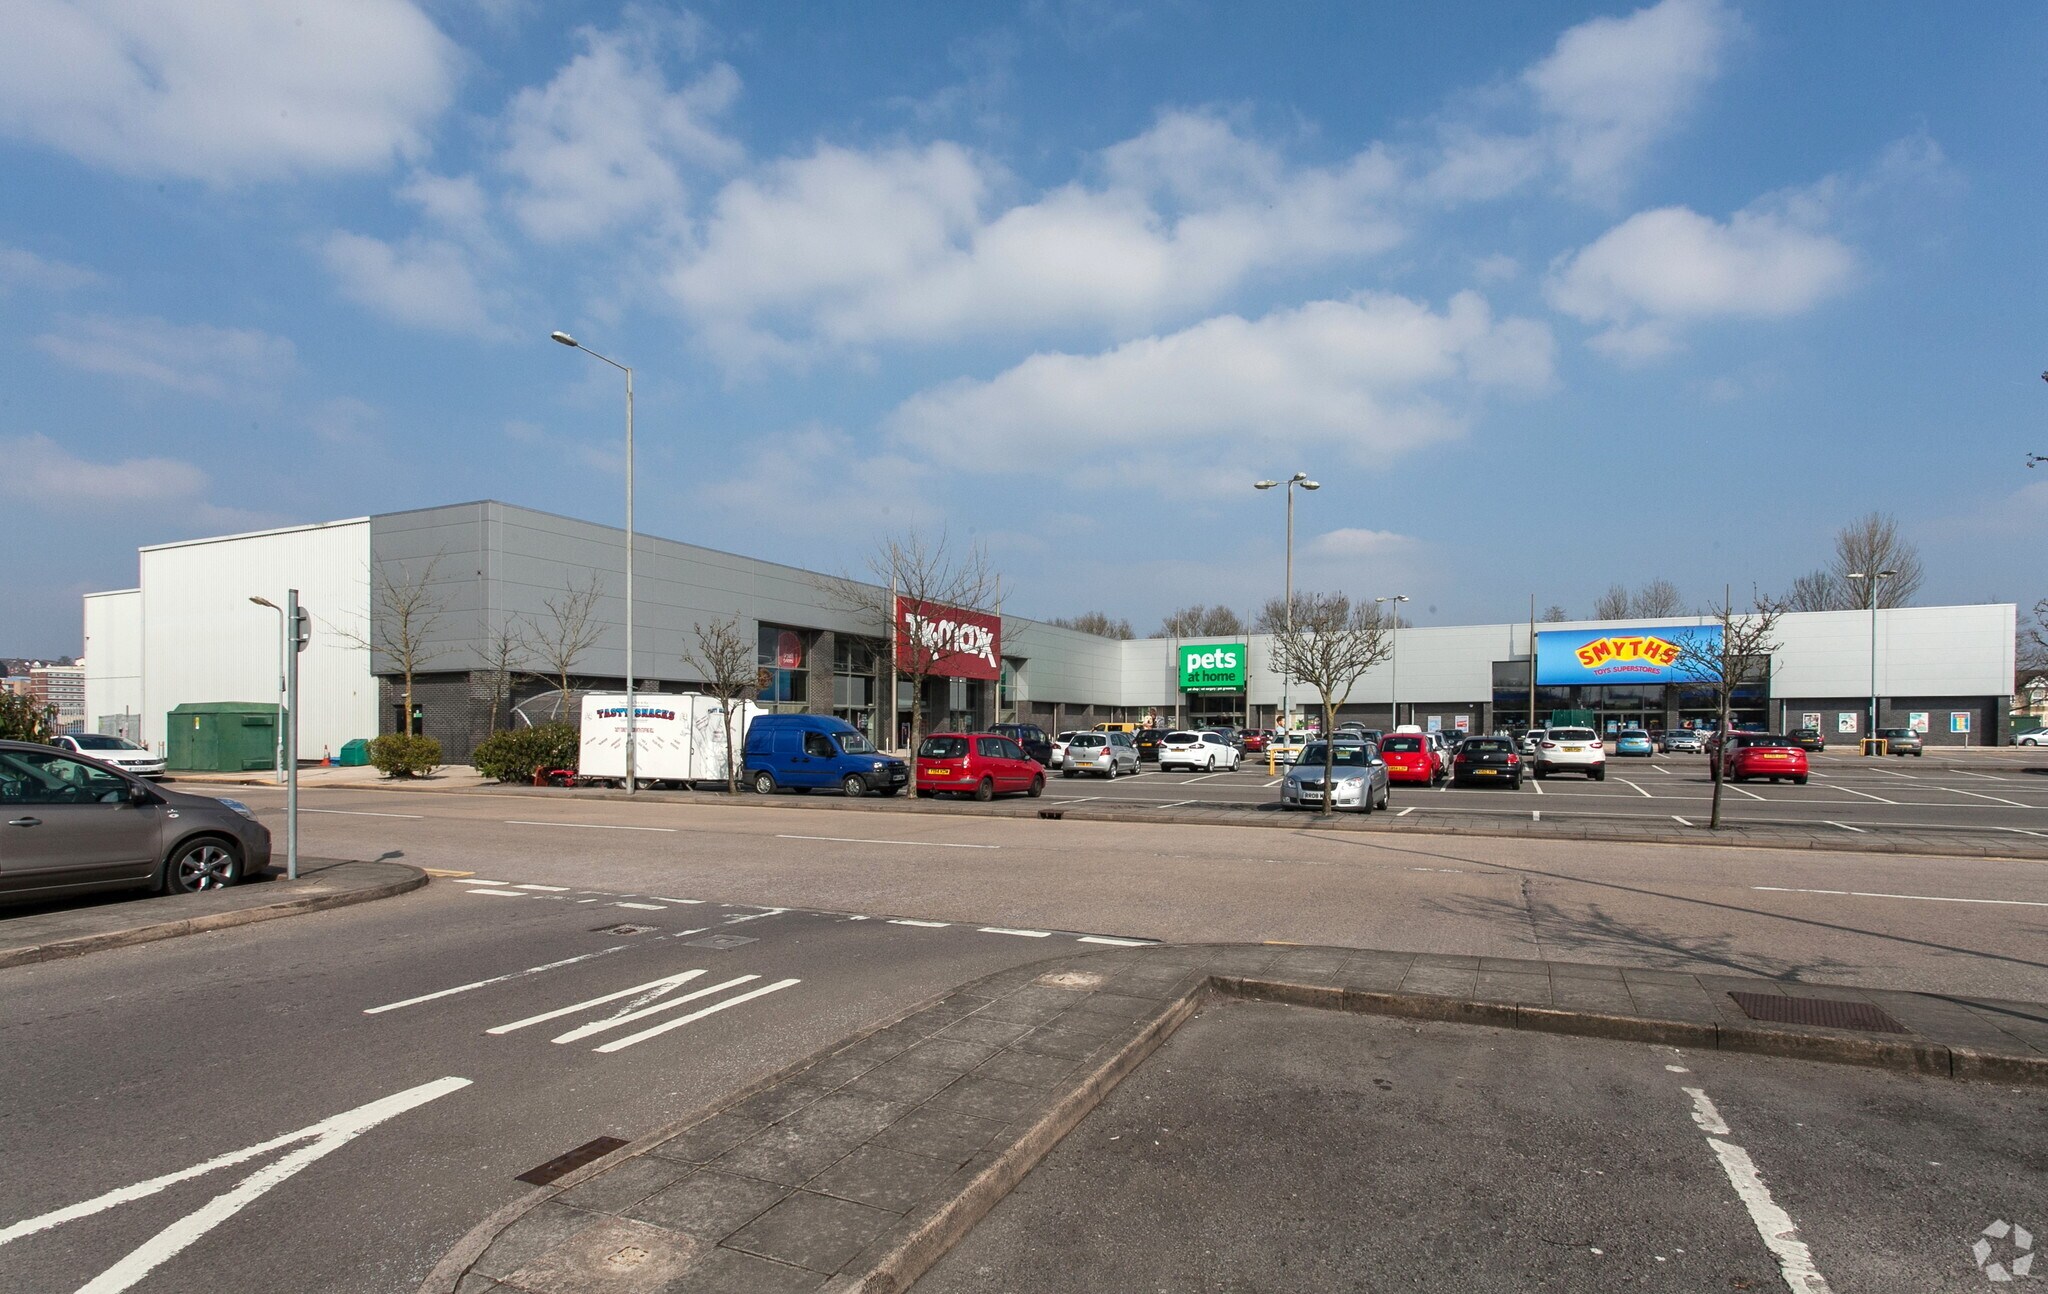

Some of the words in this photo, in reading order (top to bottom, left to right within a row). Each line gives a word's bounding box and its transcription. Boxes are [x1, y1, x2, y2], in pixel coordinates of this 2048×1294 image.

[1578, 640, 1680, 666] SMYTHS
[1187, 648, 1237, 673] pets
[1188, 671, 1200, 682] at
[1202, 670, 1236, 682] home
[1594, 667, 1611, 676] TOYS
[1613, 665, 1661, 675] SUPERSTORES
[597, 708, 628, 719] TASTY
[634, 708, 676, 721] SNACKS
